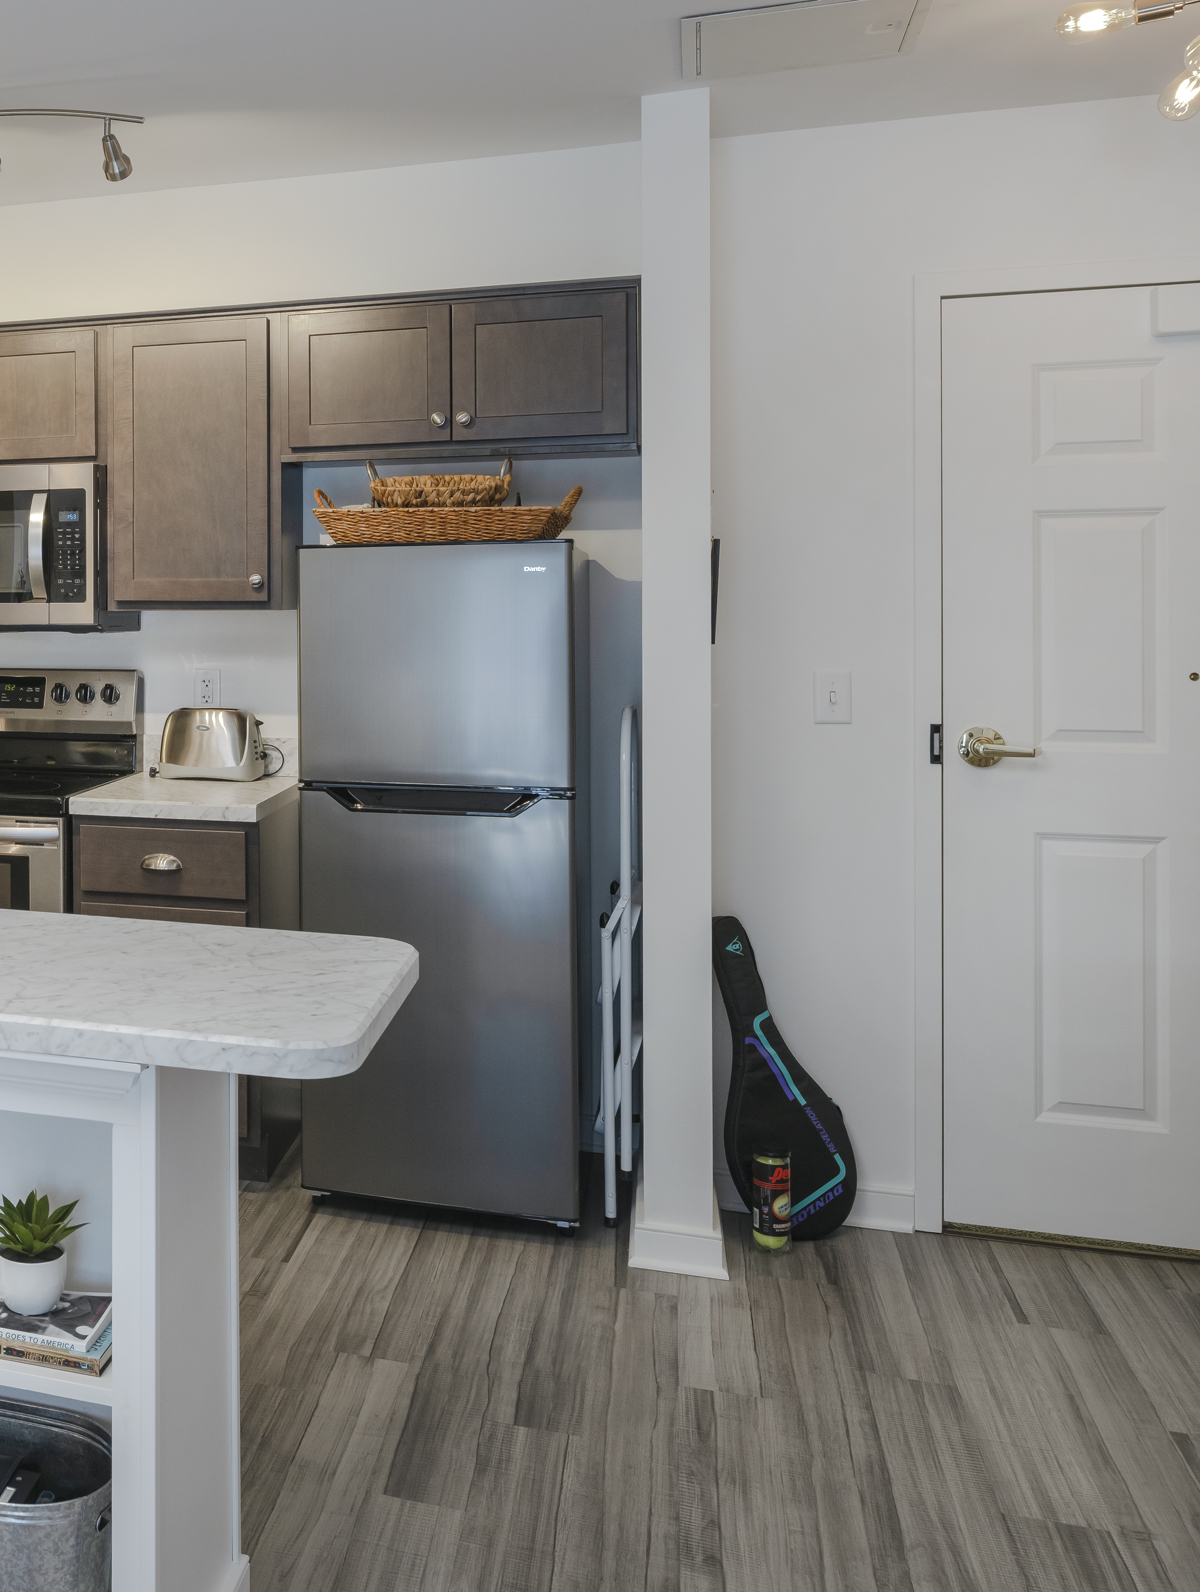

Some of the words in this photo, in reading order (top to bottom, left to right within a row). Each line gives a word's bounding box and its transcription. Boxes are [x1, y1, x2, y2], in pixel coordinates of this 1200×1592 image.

[804, 1106, 838, 1154] REVELATION
[5, 1332, 26, 1341] GOES
[29, 1336, 39, 1344] TO
[41, 1339, 75, 1350] AMERICA
